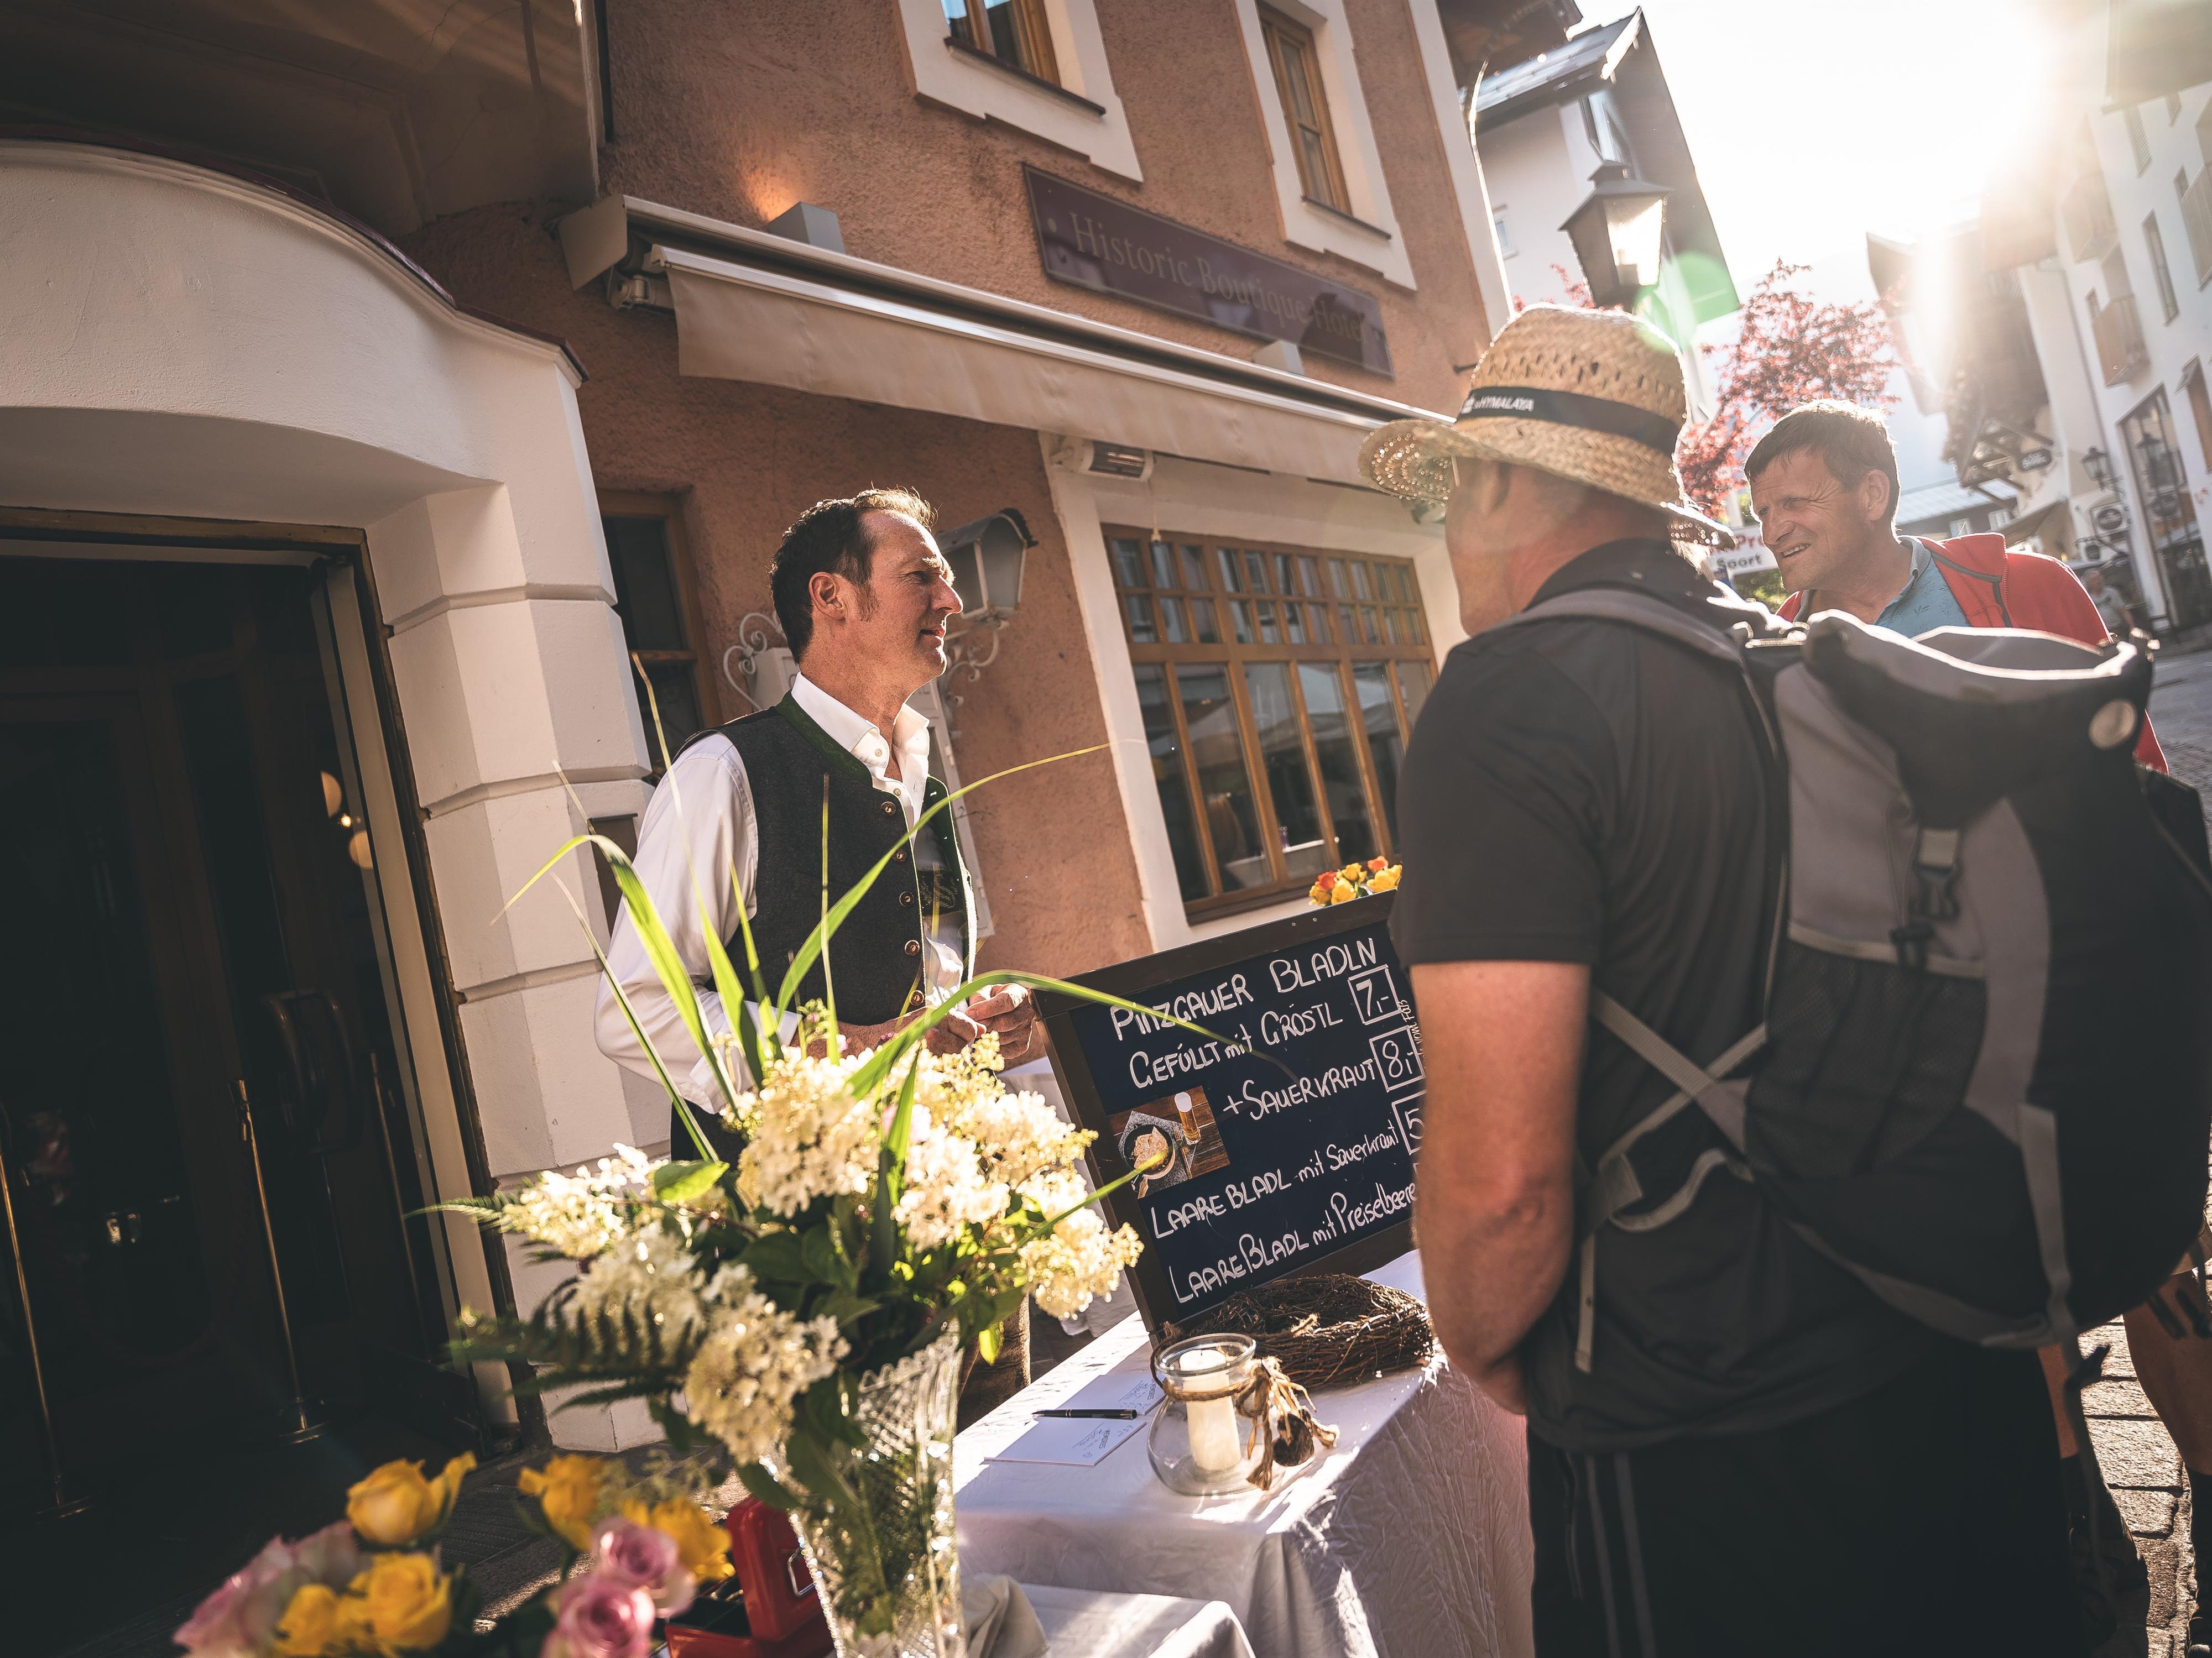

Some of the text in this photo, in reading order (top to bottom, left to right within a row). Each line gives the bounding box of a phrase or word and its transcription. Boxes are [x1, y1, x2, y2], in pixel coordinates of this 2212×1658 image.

[1070, 211, 1368, 344] Historic Boutique Hotel
[1270, 938, 1376, 993] BLADLN
[1224, 1023, 1253, 1059] mit
[1261, 1002, 1343, 1045] GRÖSTL
[1151, 1195, 1227, 1239] LAARE
[1225, 1168, 1291, 1209] BLADL
[1298, 1150, 1324, 1182] mit
[1327, 1119, 1399, 1171] Sauerkraut
[1169, 1256, 1246, 1304] LAARE
[1239, 1230, 1309, 1273] BLADL
[1313, 1210, 1337, 1245] mit
